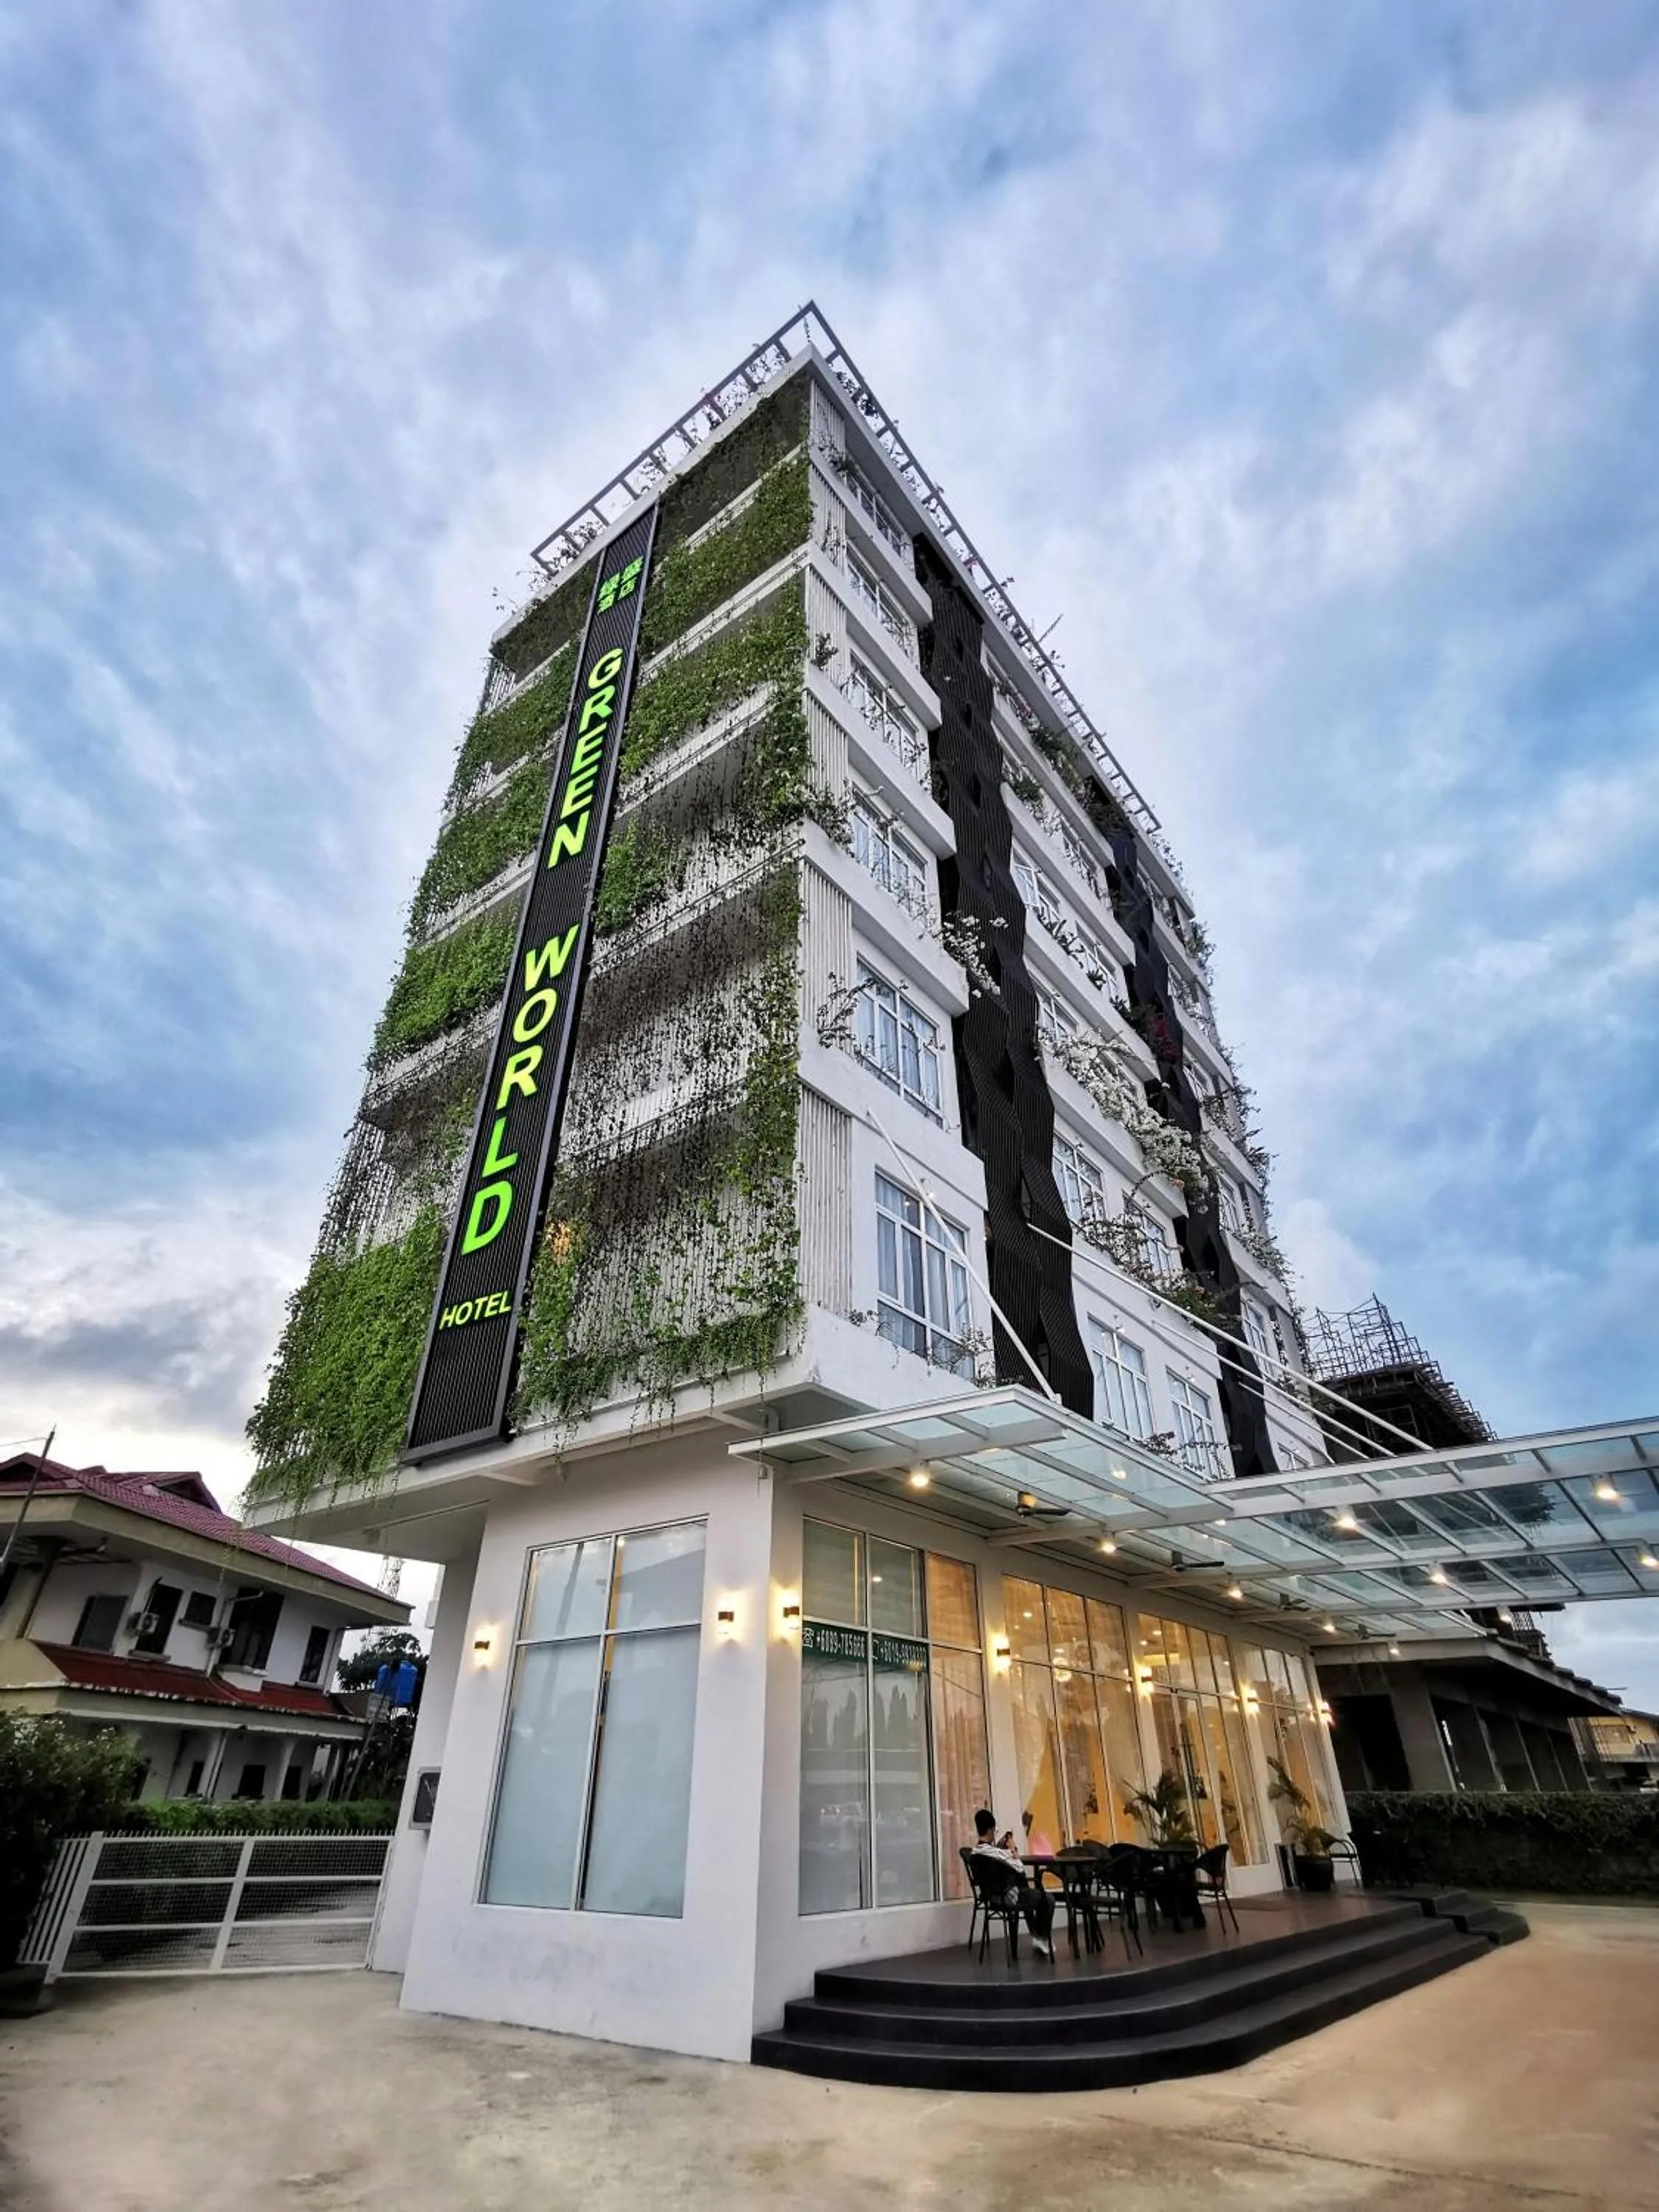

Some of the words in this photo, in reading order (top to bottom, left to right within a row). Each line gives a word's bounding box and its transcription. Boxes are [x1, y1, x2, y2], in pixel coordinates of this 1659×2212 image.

[547, 647, 622, 869] GREEN
[461, 923, 580, 1255] WORLD
[439, 1290, 512, 1330] HOTEL
